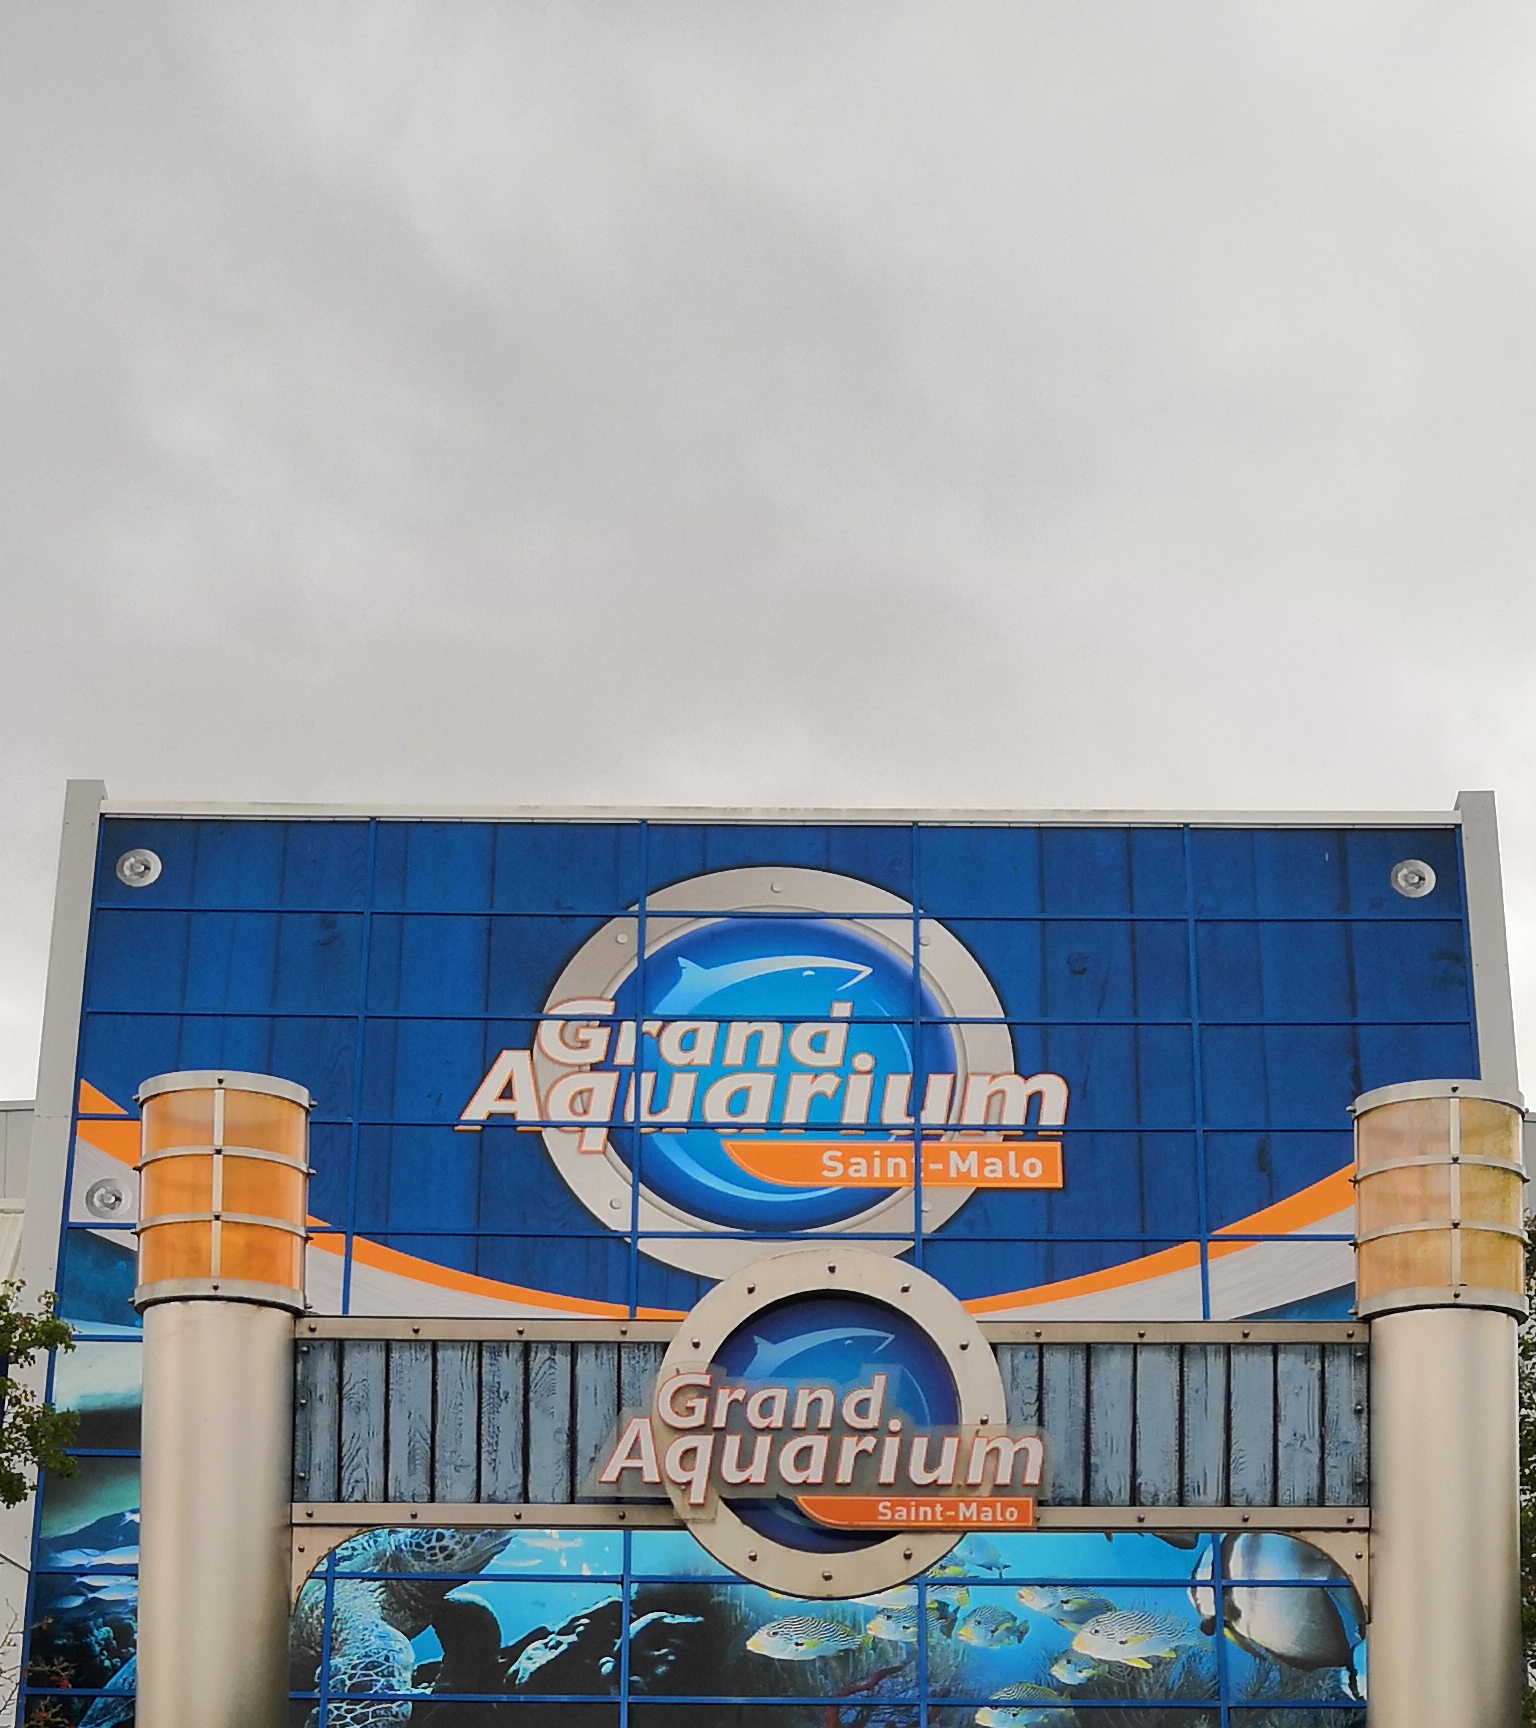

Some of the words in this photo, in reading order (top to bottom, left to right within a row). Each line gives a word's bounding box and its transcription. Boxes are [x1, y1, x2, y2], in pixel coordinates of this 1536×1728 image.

[537, 997, 853, 1068] Grand
[454, 1049, 1069, 1154] Aquarium
[822, 1150, 1044, 1178] Sain-Malo
[658, 1372, 888, 1431] Grand
[598, 1418, 1044, 1506] Aquarium
[878, 1501, 1019, 1521] Saint-Malo
